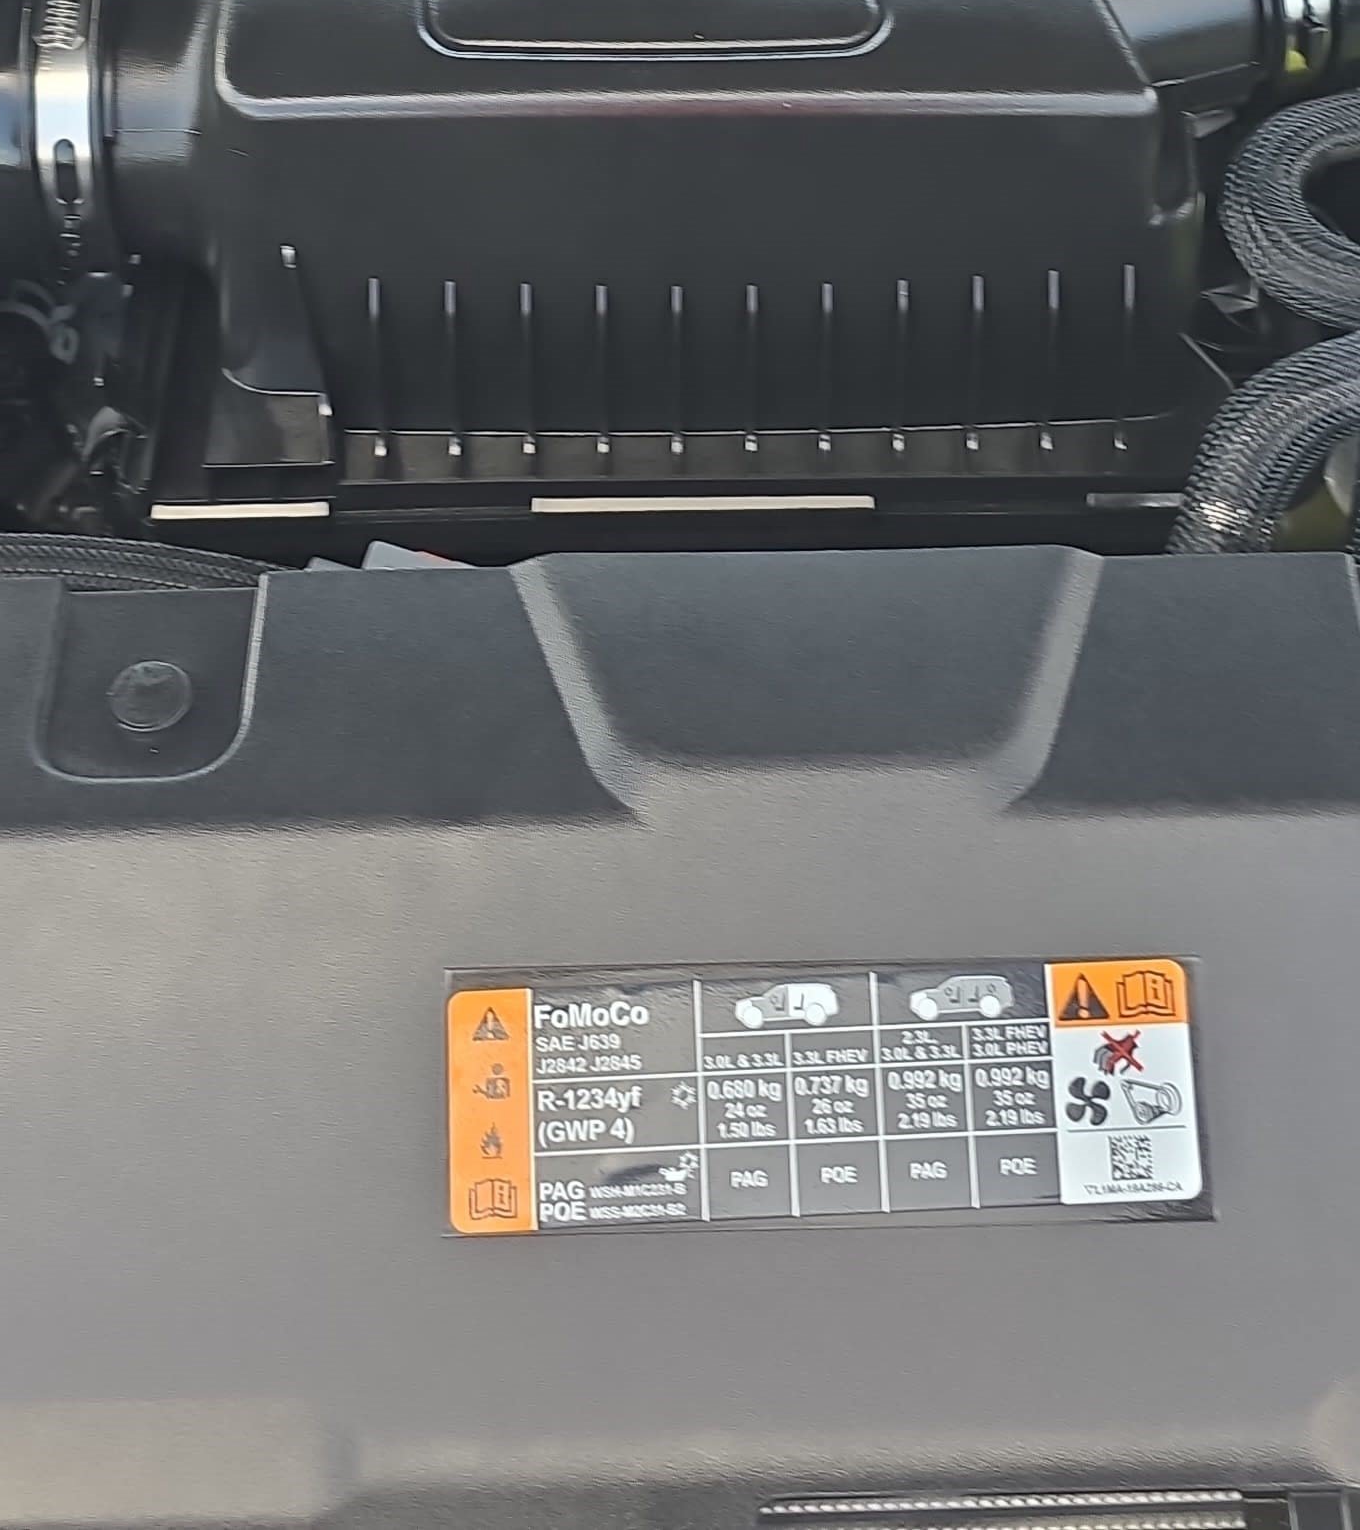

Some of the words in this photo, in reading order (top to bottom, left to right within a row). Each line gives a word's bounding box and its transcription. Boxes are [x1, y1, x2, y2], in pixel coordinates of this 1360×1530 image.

[534, 1001, 650, 1029] FoMoCo
[535, 1035, 575, 1052] SAE
[578, 1033, 621, 1050] J639
[536, 1056, 588, 1074] J2842
[590, 1054, 642, 1071] J2845
[794, 1075, 842, 1096] 0.737
[844, 1074, 869, 1098] kg
[887, 1070, 937, 1090] 0.992
[938, 1069, 962, 1092] kg
[975, 1067, 1024, 1088] 0.992
[1026, 1066, 1050, 1090] kg
[537, 1085, 642, 1113] R-1234yf
[707, 1079, 756, 1100] 0.680
[758, 1078, 782, 1102] kg
[992, 1090, 1014, 1106] 35
[1014, 1092, 1036, 1106] oz
[724, 1102, 745, 1119] 24
[746, 1104, 768, 1118] oz
[811, 1098, 832, 1115] 26
[833, 1100, 855, 1114] oz
[906, 1093, 926, 1109] 35
[927, 1095, 948, 1108] oz
[804, 1118, 837, 1135] 1.63
[837, 1117, 864, 1133] lbs
[898, 1112, 931, 1129] 2.19
[931, 1111, 958, 1127] lbs
[985, 1109, 1018, 1127] 2.19
[1019, 1108, 1046, 1125] lbs
[538, 1120, 606, 1148] (GWP
[610, 1117, 635, 1144] 4)
[716, 1121, 750, 1139] 1.50
[751, 1121, 776, 1137] lbs
[730, 1170, 768, 1188] PAG
[910, 1161, 948, 1180] PAG
[539, 1181, 585, 1201] PAG
